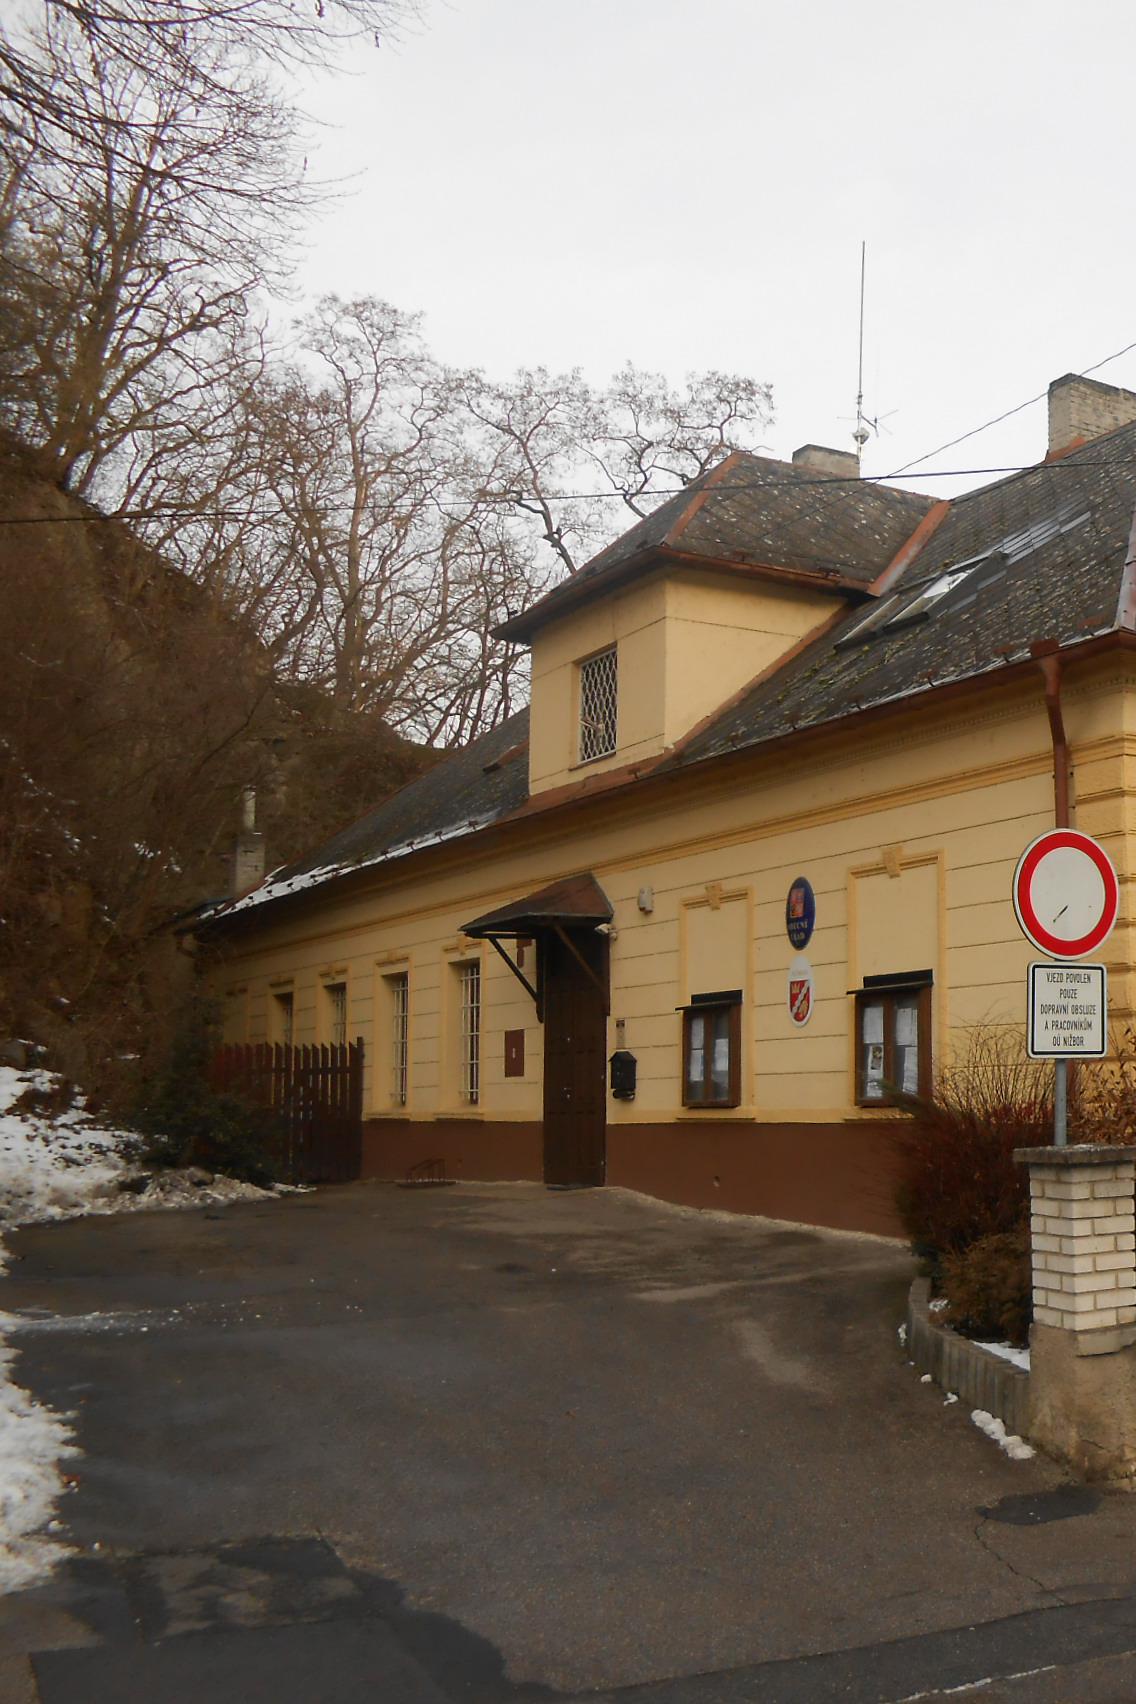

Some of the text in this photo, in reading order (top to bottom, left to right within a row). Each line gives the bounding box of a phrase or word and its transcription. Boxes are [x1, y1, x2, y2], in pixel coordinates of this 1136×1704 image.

[1046, 972, 1092, 984] VJEZD POVOLEN
[1059, 988, 1078, 999] POUZE
[1044, 1020, 1049, 1031] A
